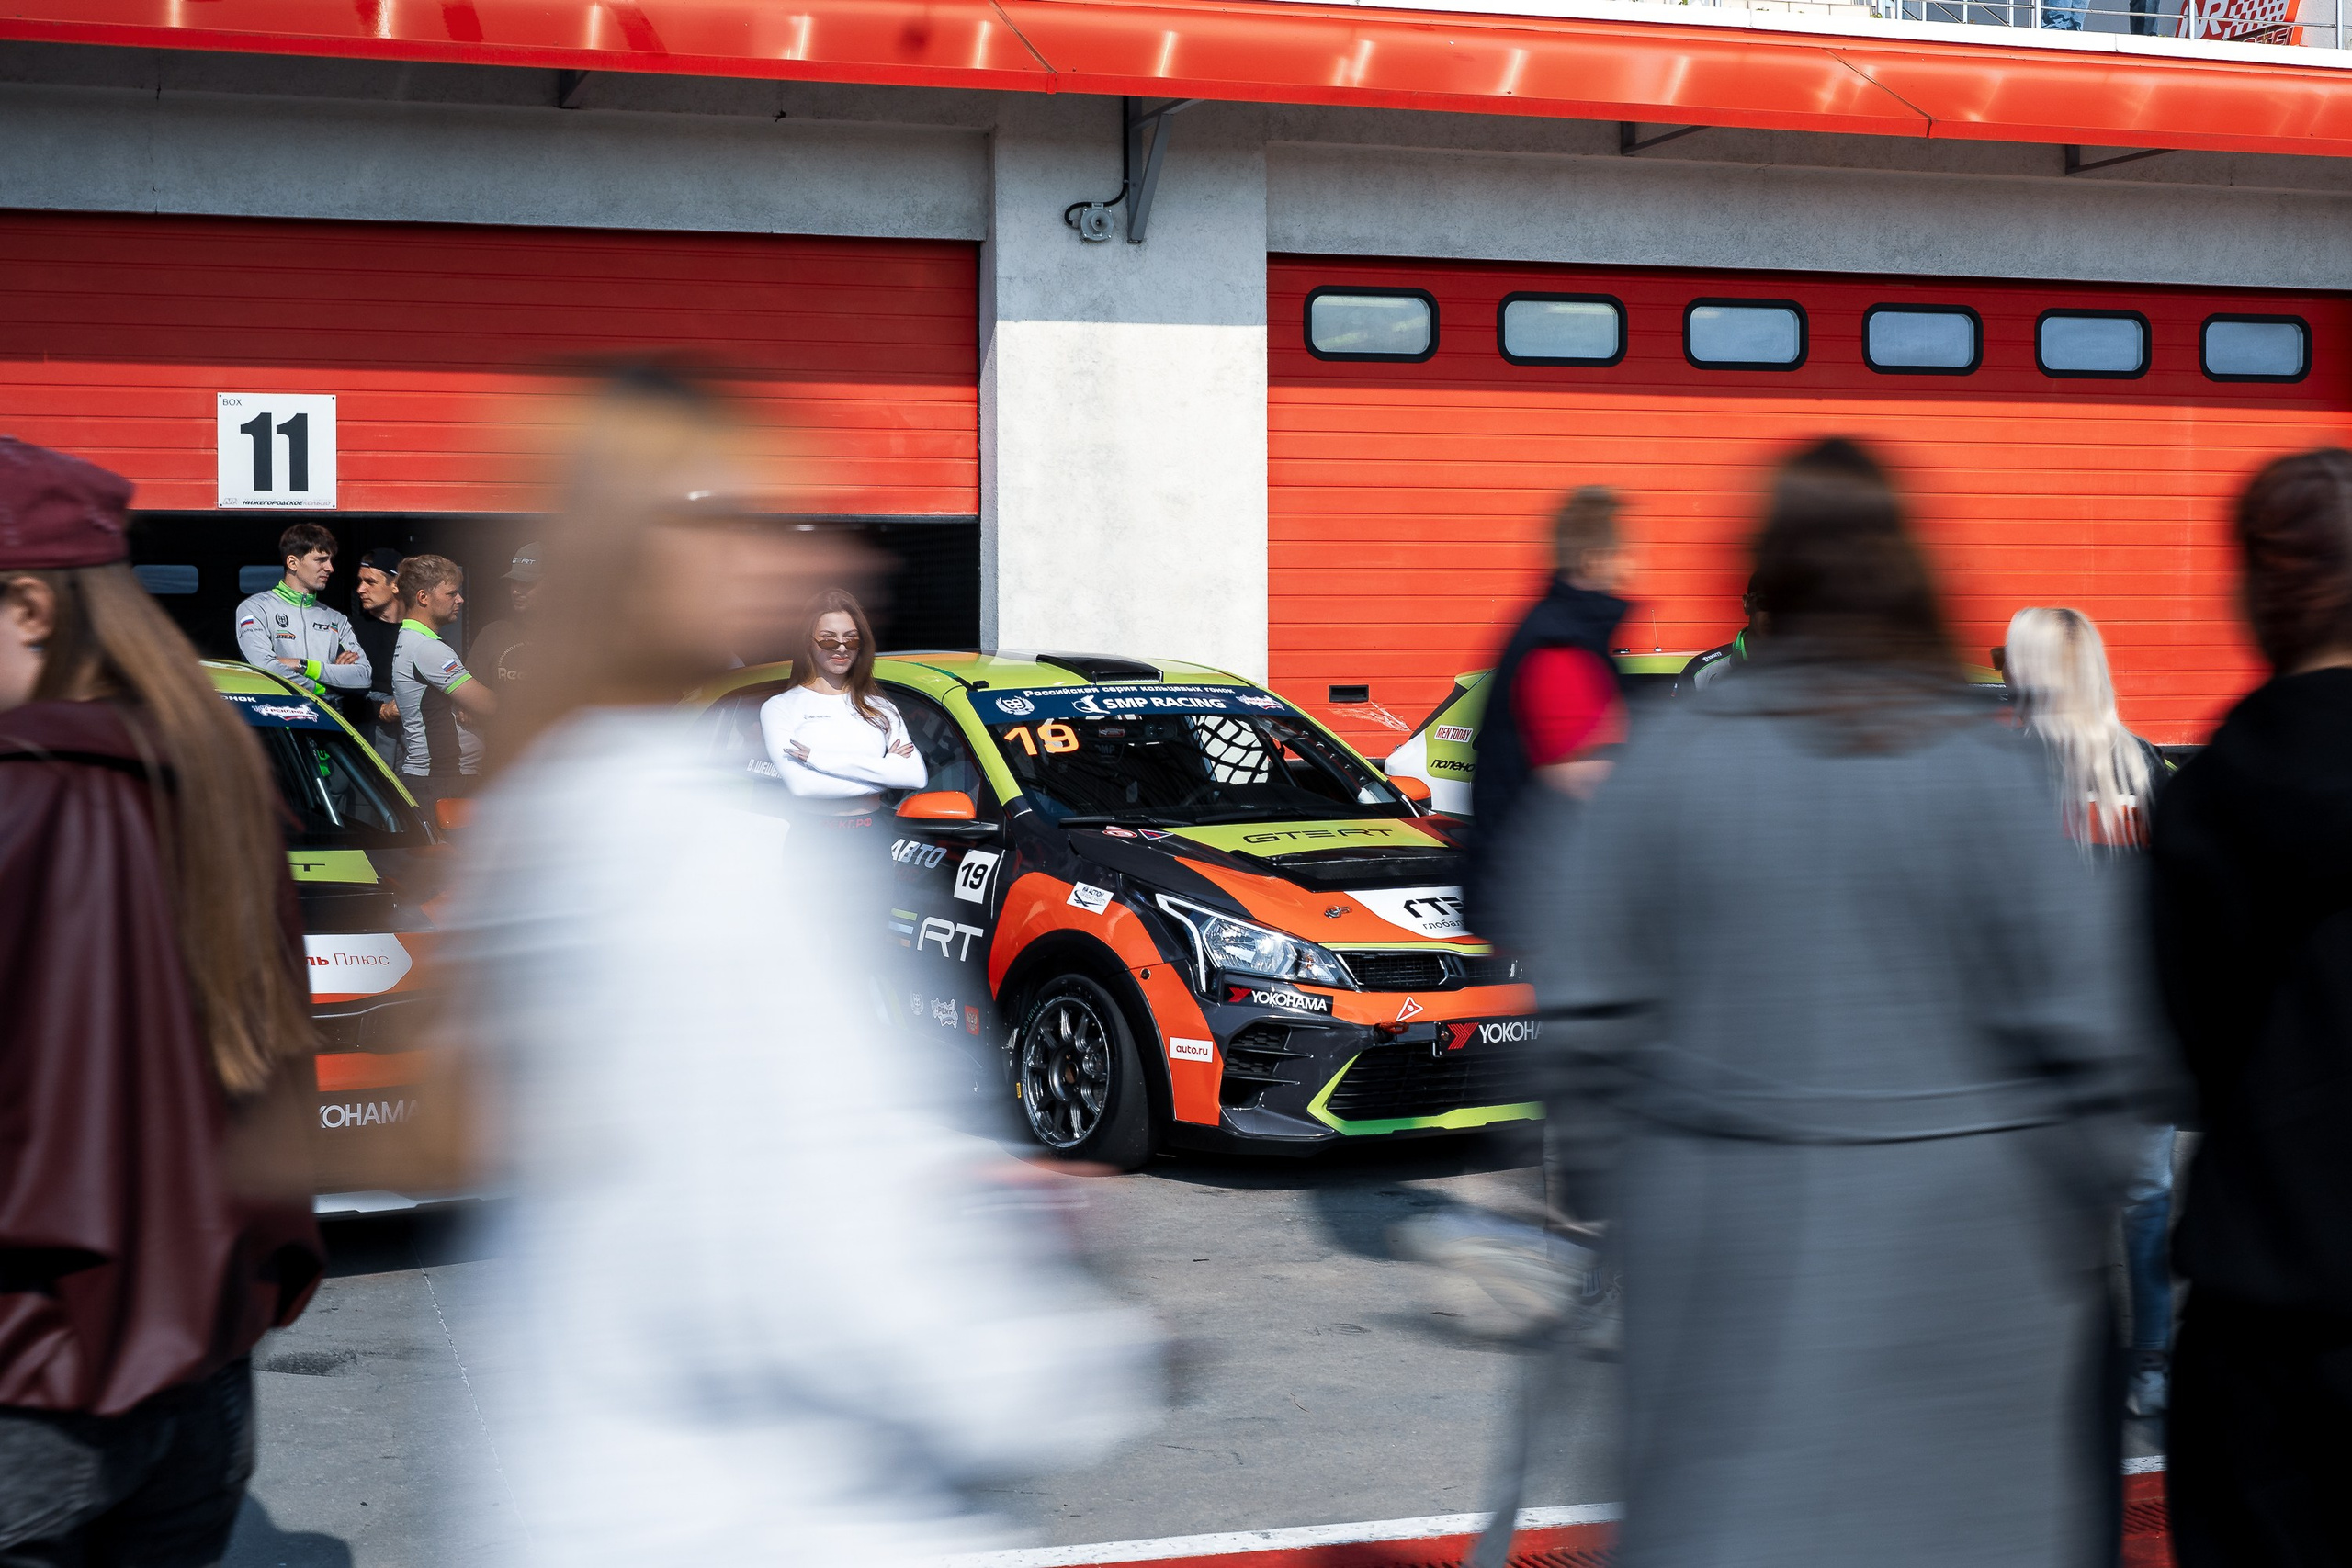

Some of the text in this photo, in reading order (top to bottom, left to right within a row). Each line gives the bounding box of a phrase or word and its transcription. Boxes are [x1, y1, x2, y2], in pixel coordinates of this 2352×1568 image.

[222, 398, 242, 406] BOX
[241, 412, 308, 491] 11
[1023, 687, 1100, 697] Российская
[1102, 685, 1138, 694] серия
[1102, 697, 1148, 709] SMP
[1150, 697, 1227, 709] RACING
[1003, 723, 1080, 756] 19
[1436, 727, 1472, 741] MEN TODAY
[961, 861, 989, 890] 19
[1423, 919, 1464, 930] глобал
[334, 953, 390, 966] Плюс
[1251, 990, 1328, 1011] YOKOHAMA
[1478, 1021, 1544, 1044] YOKOHA
[1176, 1043, 1209, 1055] auto.ru
